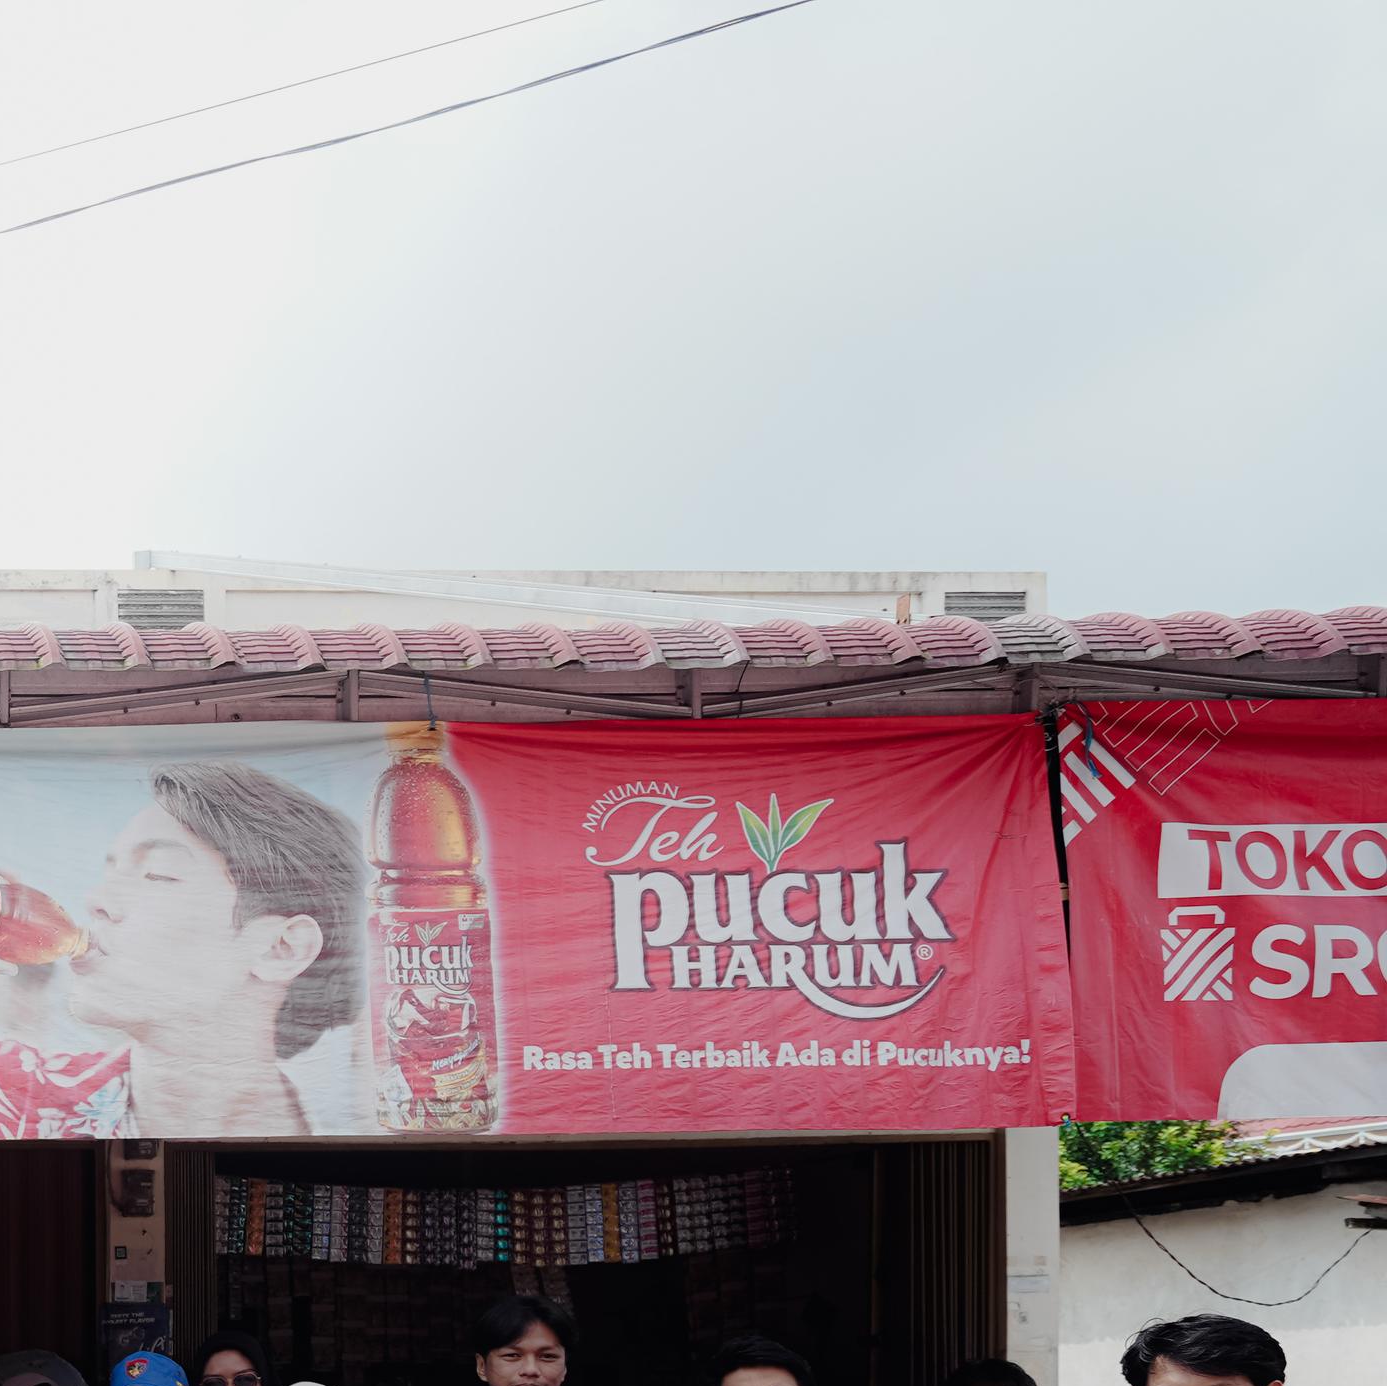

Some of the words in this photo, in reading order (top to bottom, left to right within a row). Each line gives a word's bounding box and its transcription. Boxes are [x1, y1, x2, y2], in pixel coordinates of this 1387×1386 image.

[582, 781, 679, 833] MINUMAN
[586, 795, 723, 865] Teh
[1188, 829, 1387, 891] TOKO
[394, 968, 472, 995] HARUM
[669, 943, 945, 1019] HARUM
[1249, 924, 1387, 1000] SR
[523, 1045, 593, 1070] Rasa
[598, 1043, 652, 1069] Teh
[657, 1042, 772, 1068] Terbaik
[776, 1042, 836, 1067] Ada
[842, 1040, 870, 1066] di
[877, 1039, 1031, 1072] Pucuknya!
